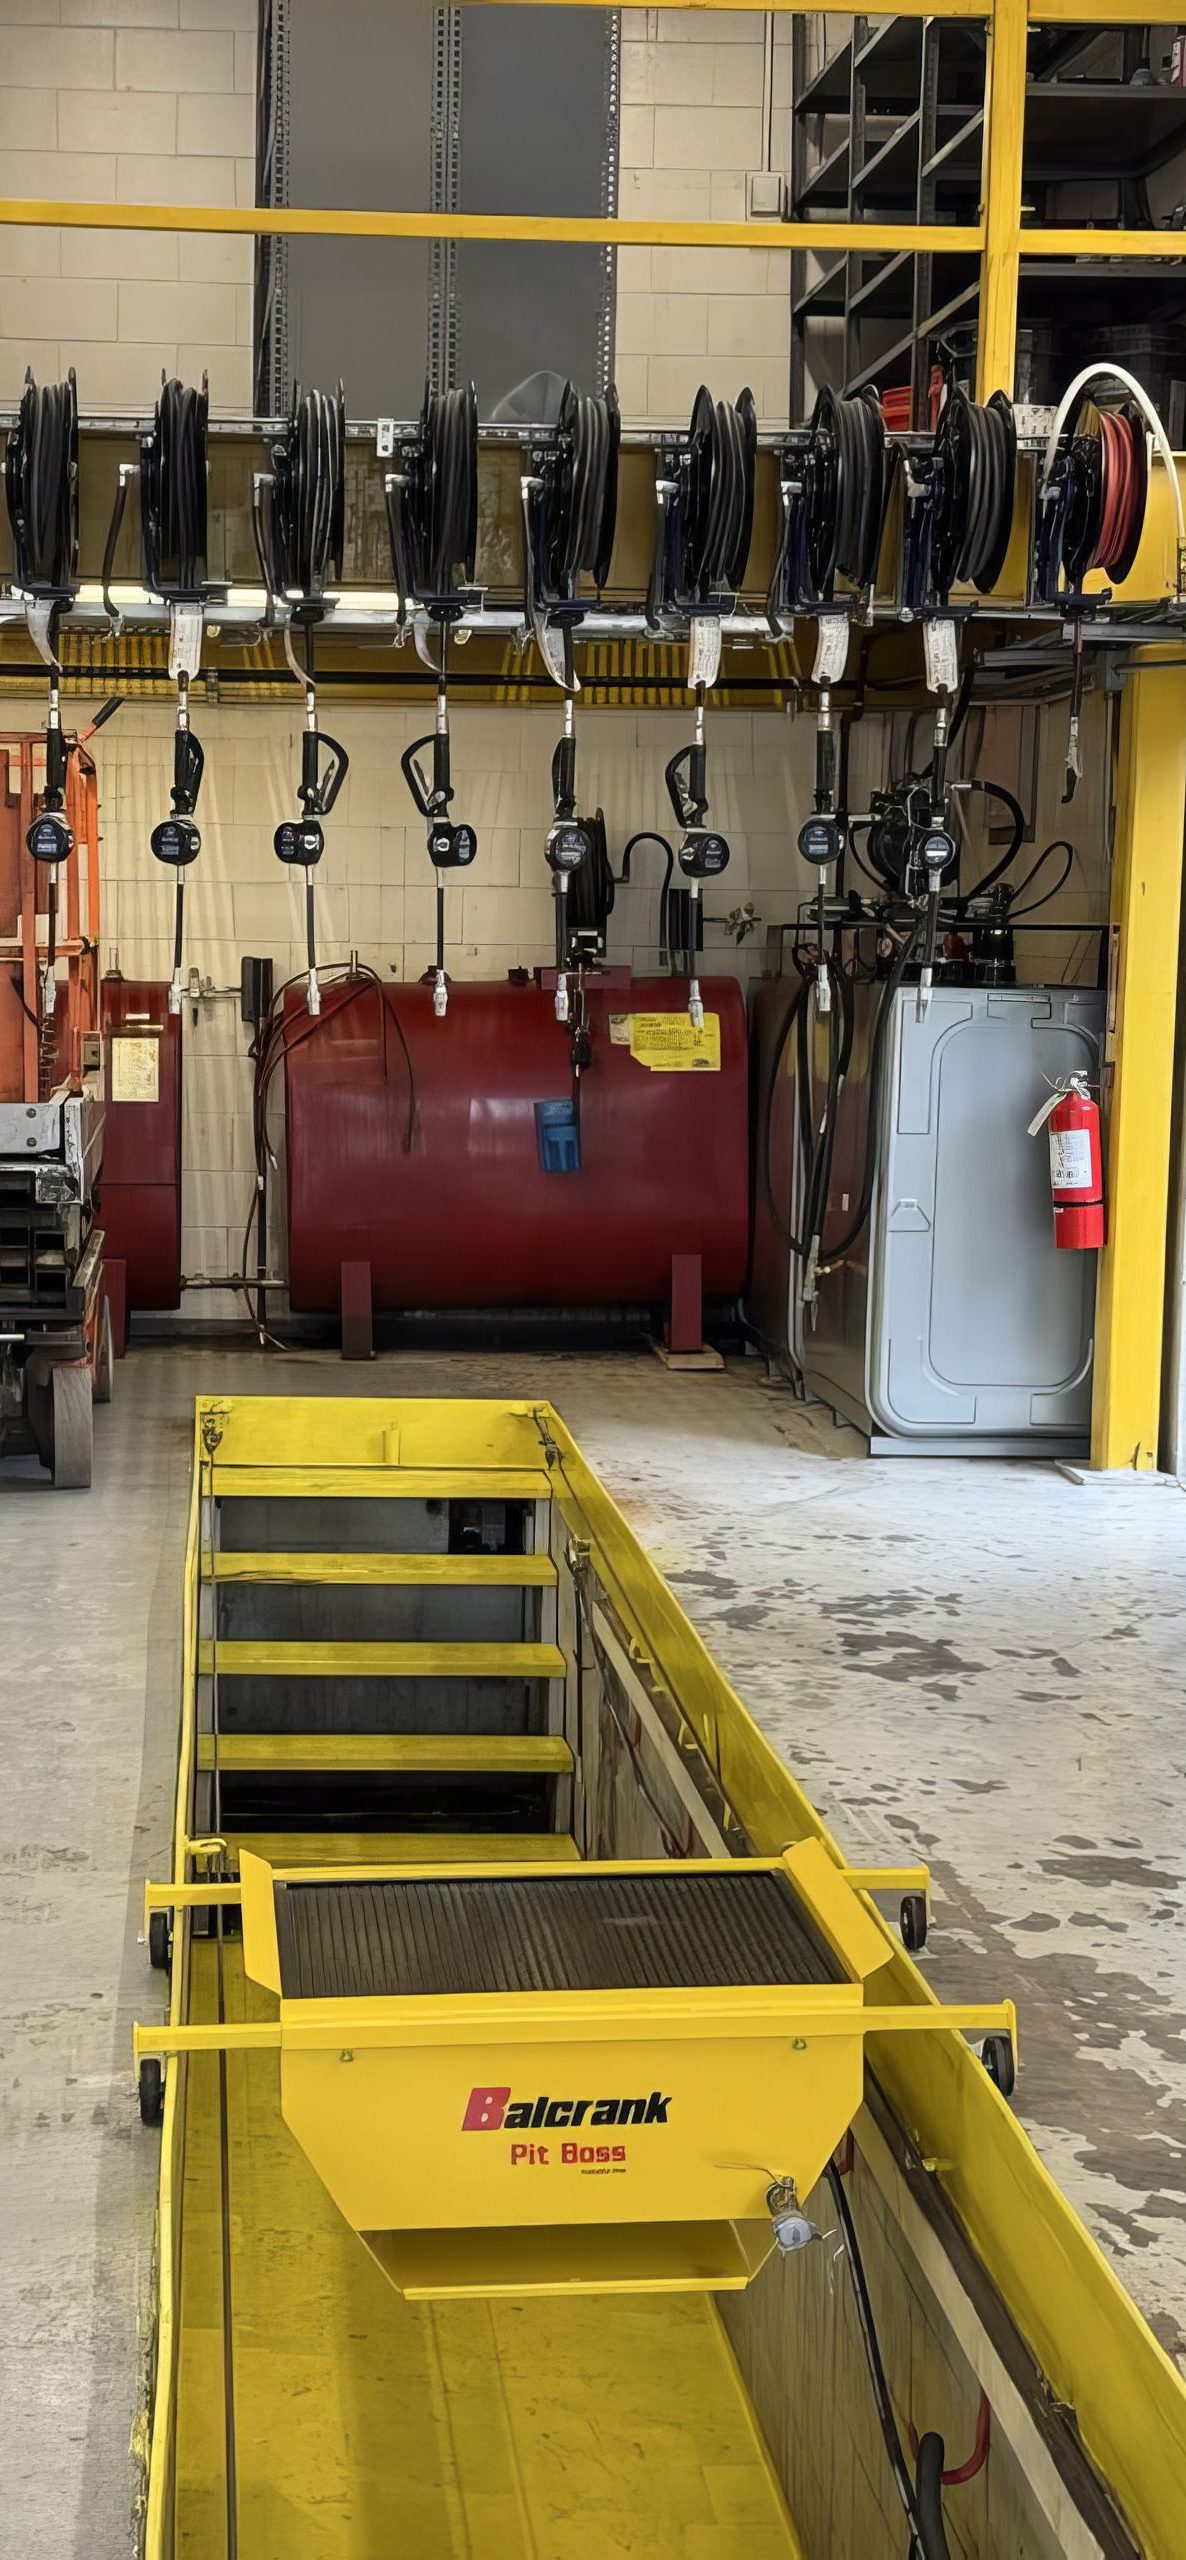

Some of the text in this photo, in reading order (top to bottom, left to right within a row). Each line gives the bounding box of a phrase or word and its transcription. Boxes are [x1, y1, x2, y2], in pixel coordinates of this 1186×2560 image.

[461, 2087, 672, 2131] Balcrank
[510, 2142, 626, 2166] Pit Boss
